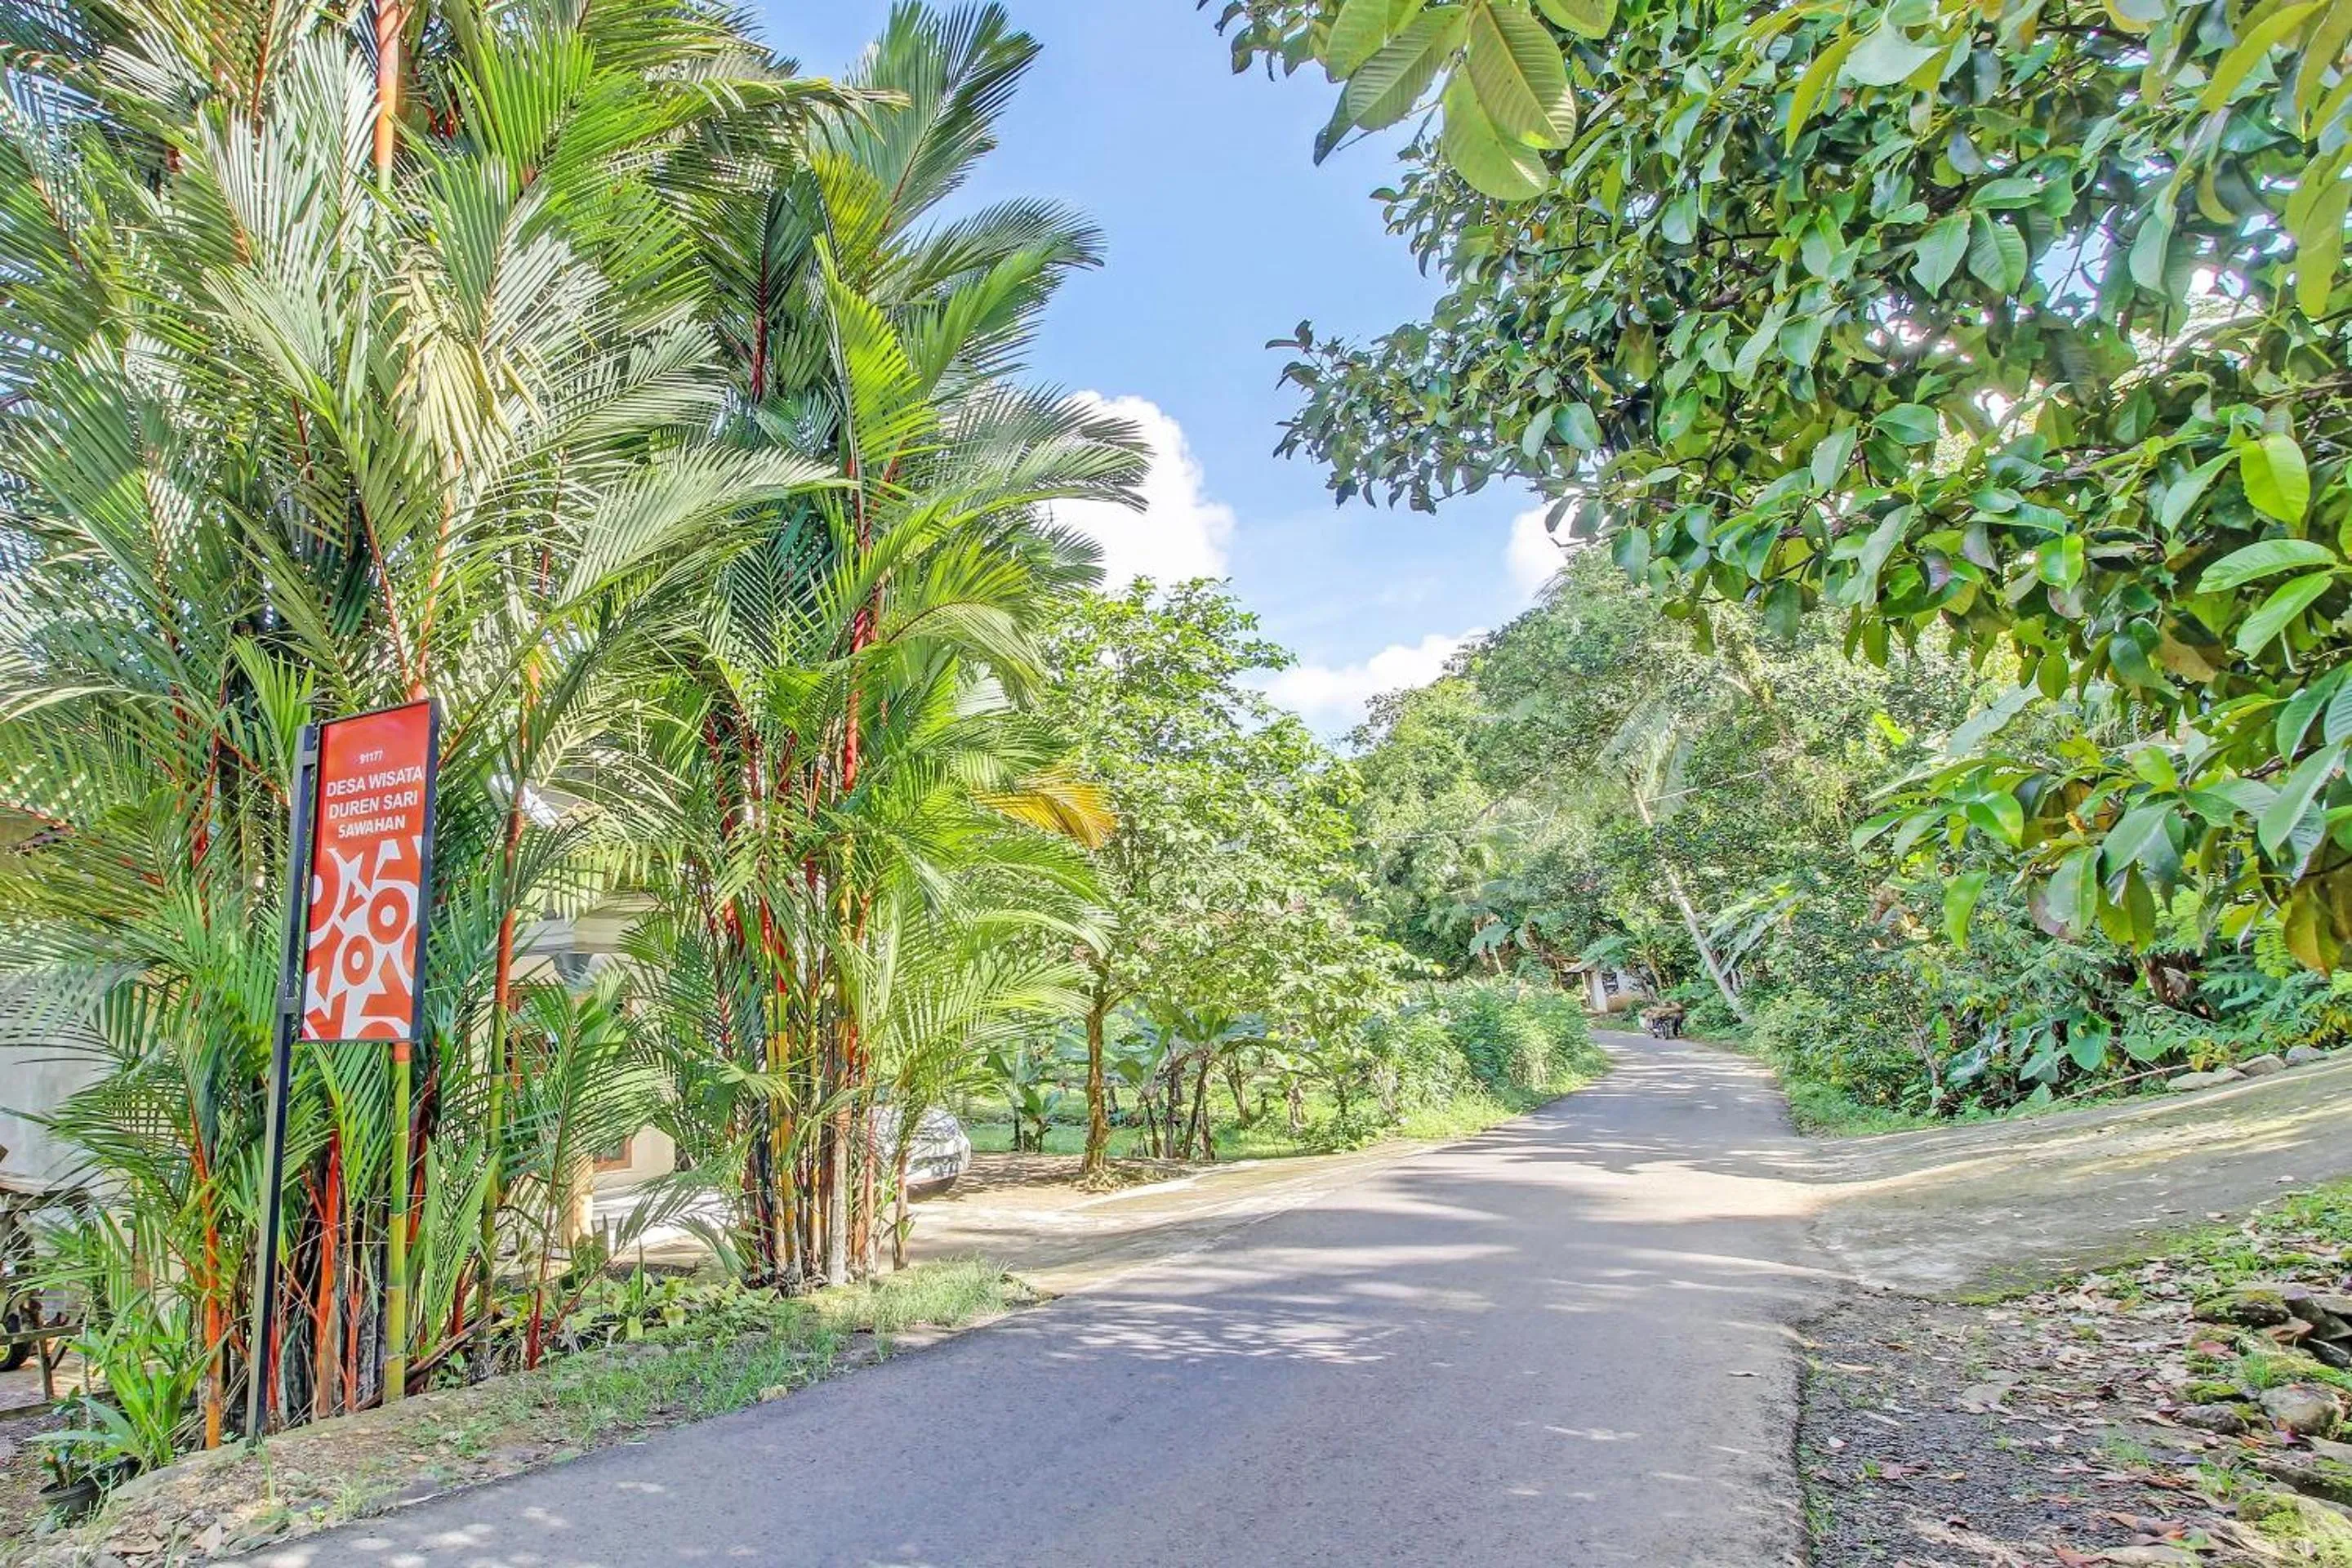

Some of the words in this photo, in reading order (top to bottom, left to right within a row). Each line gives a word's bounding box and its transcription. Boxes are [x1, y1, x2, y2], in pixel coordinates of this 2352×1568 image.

[327, 777, 366, 797] DESA
[369, 766, 424, 789] WISATA
[328, 796, 379, 819] DUREN
[383, 791, 418, 810] SARI
[338, 815, 405, 839] SAWAHAN
